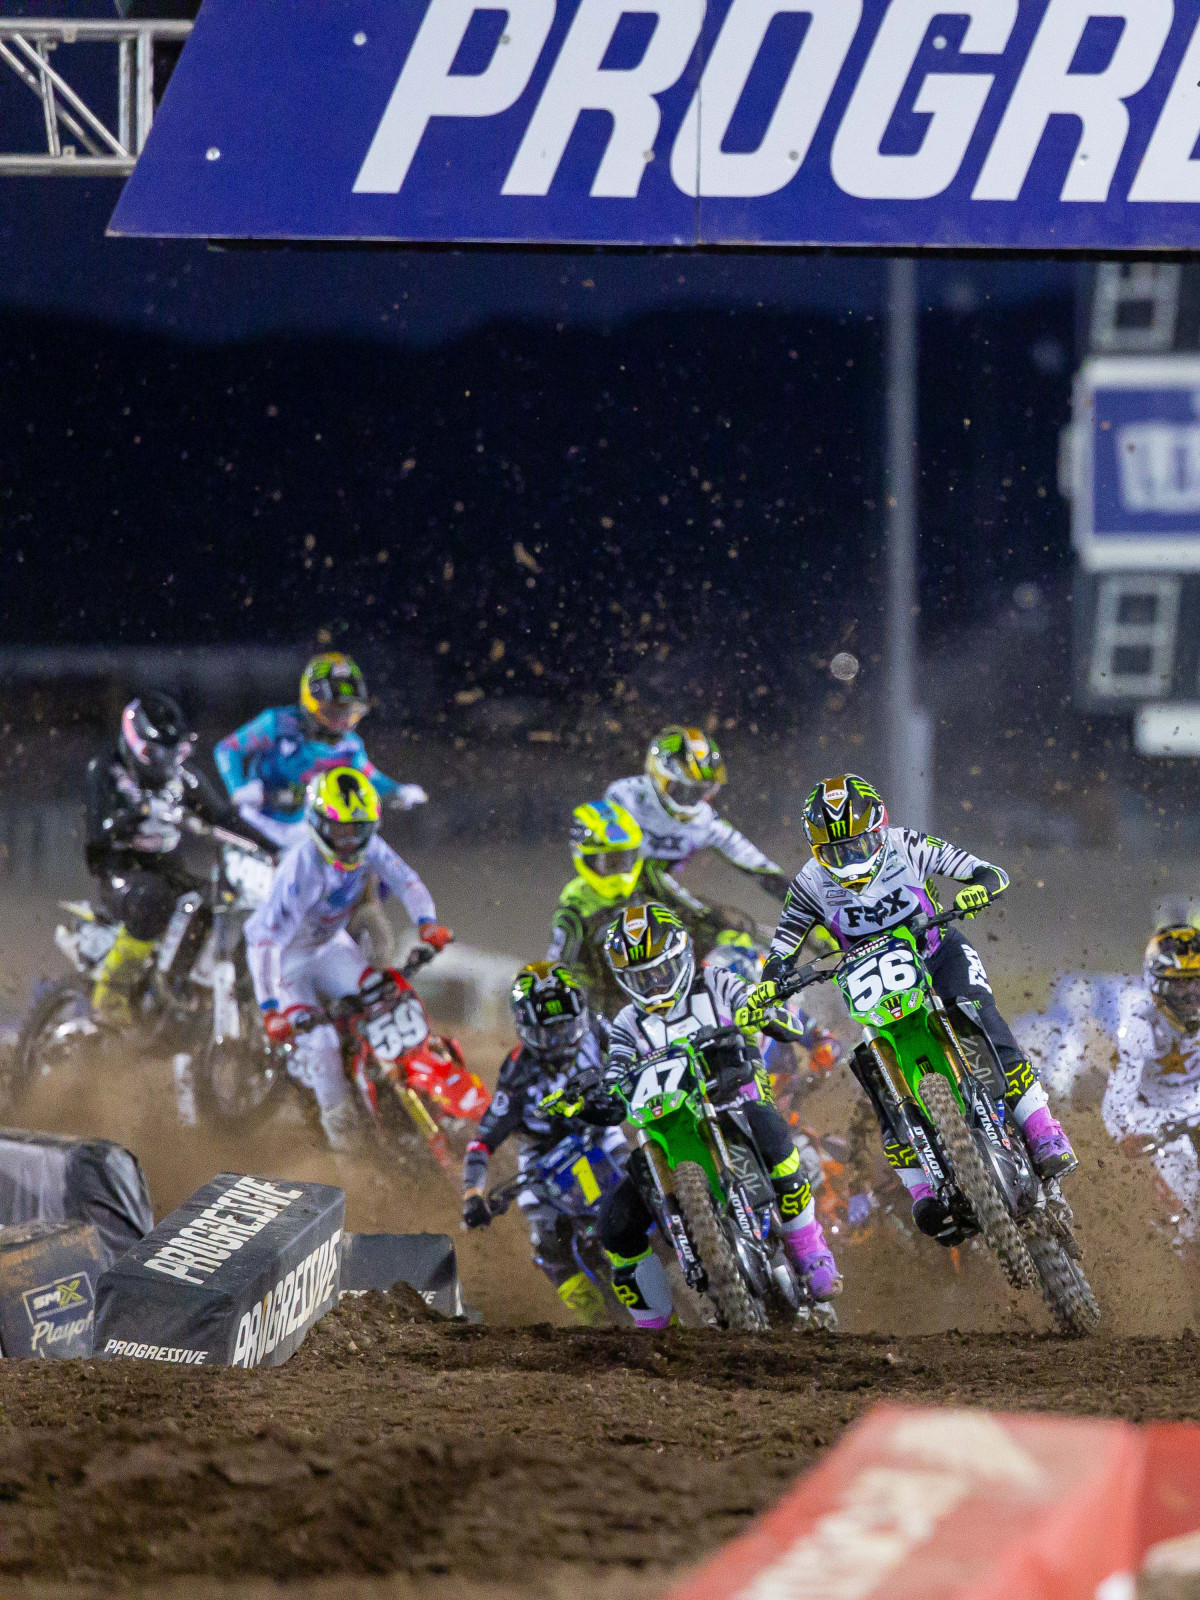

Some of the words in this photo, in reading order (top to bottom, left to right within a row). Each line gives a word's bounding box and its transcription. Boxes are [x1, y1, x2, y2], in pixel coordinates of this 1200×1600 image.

[847, 949, 917, 1012] 56
[366, 999, 429, 1061] 59
[631, 1056, 688, 1109] 47
[570, 1155, 602, 1206] 1
[143, 1176, 304, 1285] PROGRESSIVE
[232, 1227, 344, 1370] PROGRESSIVE
[104, 1338, 209, 1366] PROGRESSIVE
